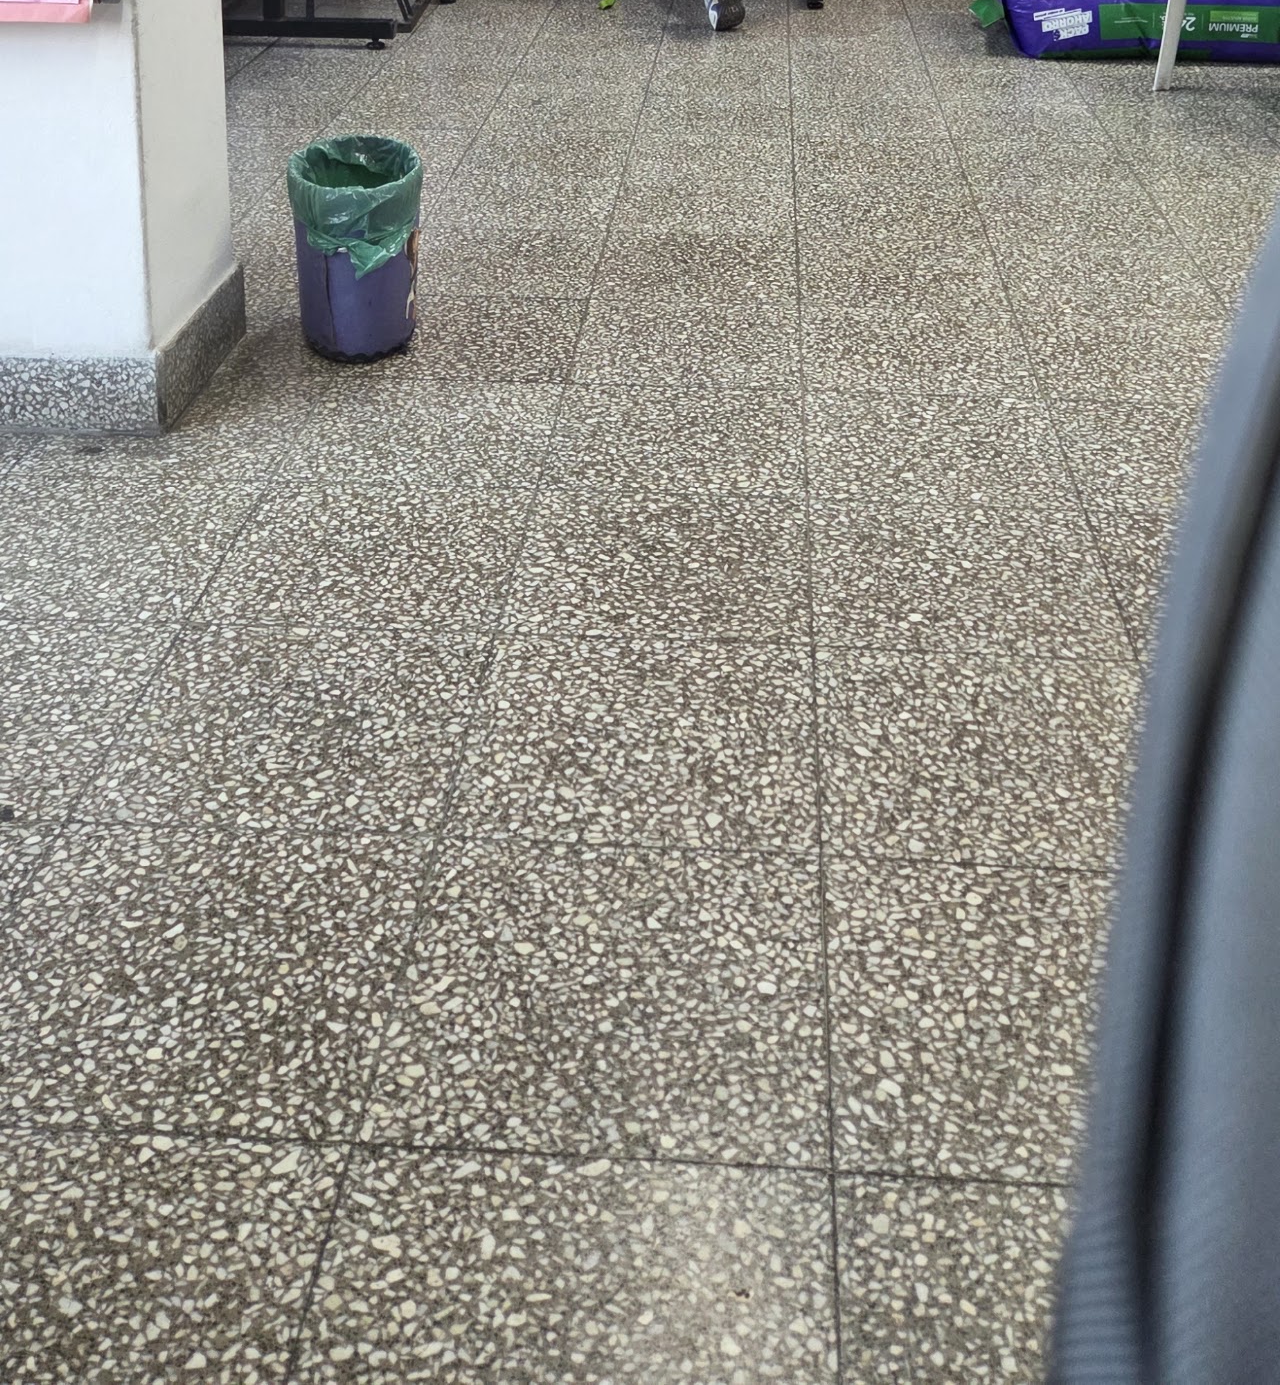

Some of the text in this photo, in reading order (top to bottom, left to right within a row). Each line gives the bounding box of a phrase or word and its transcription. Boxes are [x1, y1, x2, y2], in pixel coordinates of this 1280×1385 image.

[1042, 12, 1091, 32] AHORRO
[1209, 23, 1258, 33] PREMIUM
[1059, 24, 1089, 40] PACK
